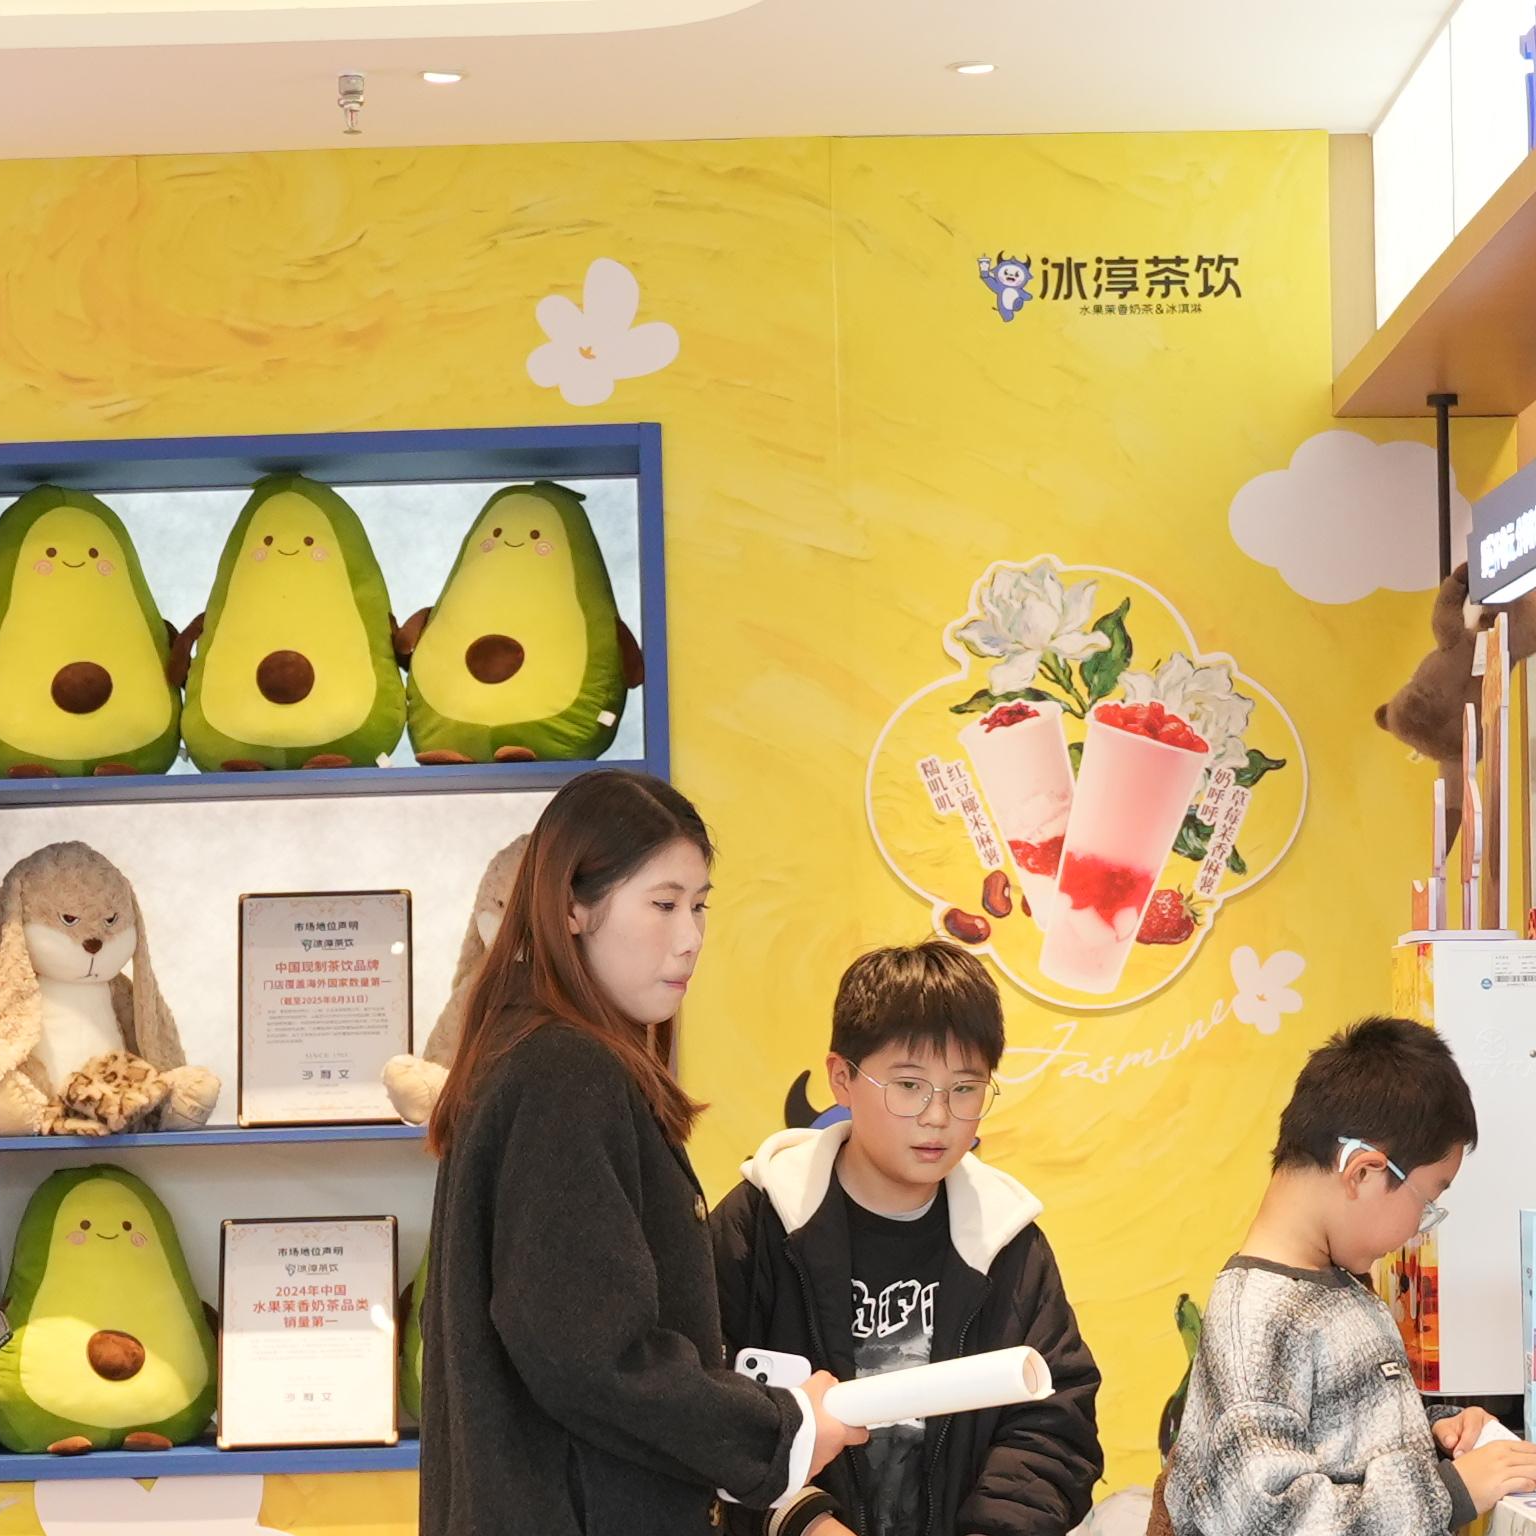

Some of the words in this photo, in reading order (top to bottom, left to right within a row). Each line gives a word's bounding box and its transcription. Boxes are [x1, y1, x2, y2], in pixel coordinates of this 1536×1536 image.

[1039, 254, 1242, 301] 冰淳茶饮
[294, 920, 359, 932] 市场地位声明
[275, 959, 380, 974] 中国现制茶饮品牌
[264, 977, 392, 991] 门店覆盖海外国家数量第一
[994, 998, 1234, 1085] Jasmine
[277, 1246, 344, 1257] 市场地位声明
[275, 1284, 347, 1297] 2024年中国
[253, 1299, 369, 1314] 水果茉香奶茶品类
[283, 1316, 338, 1329] 销量第一
